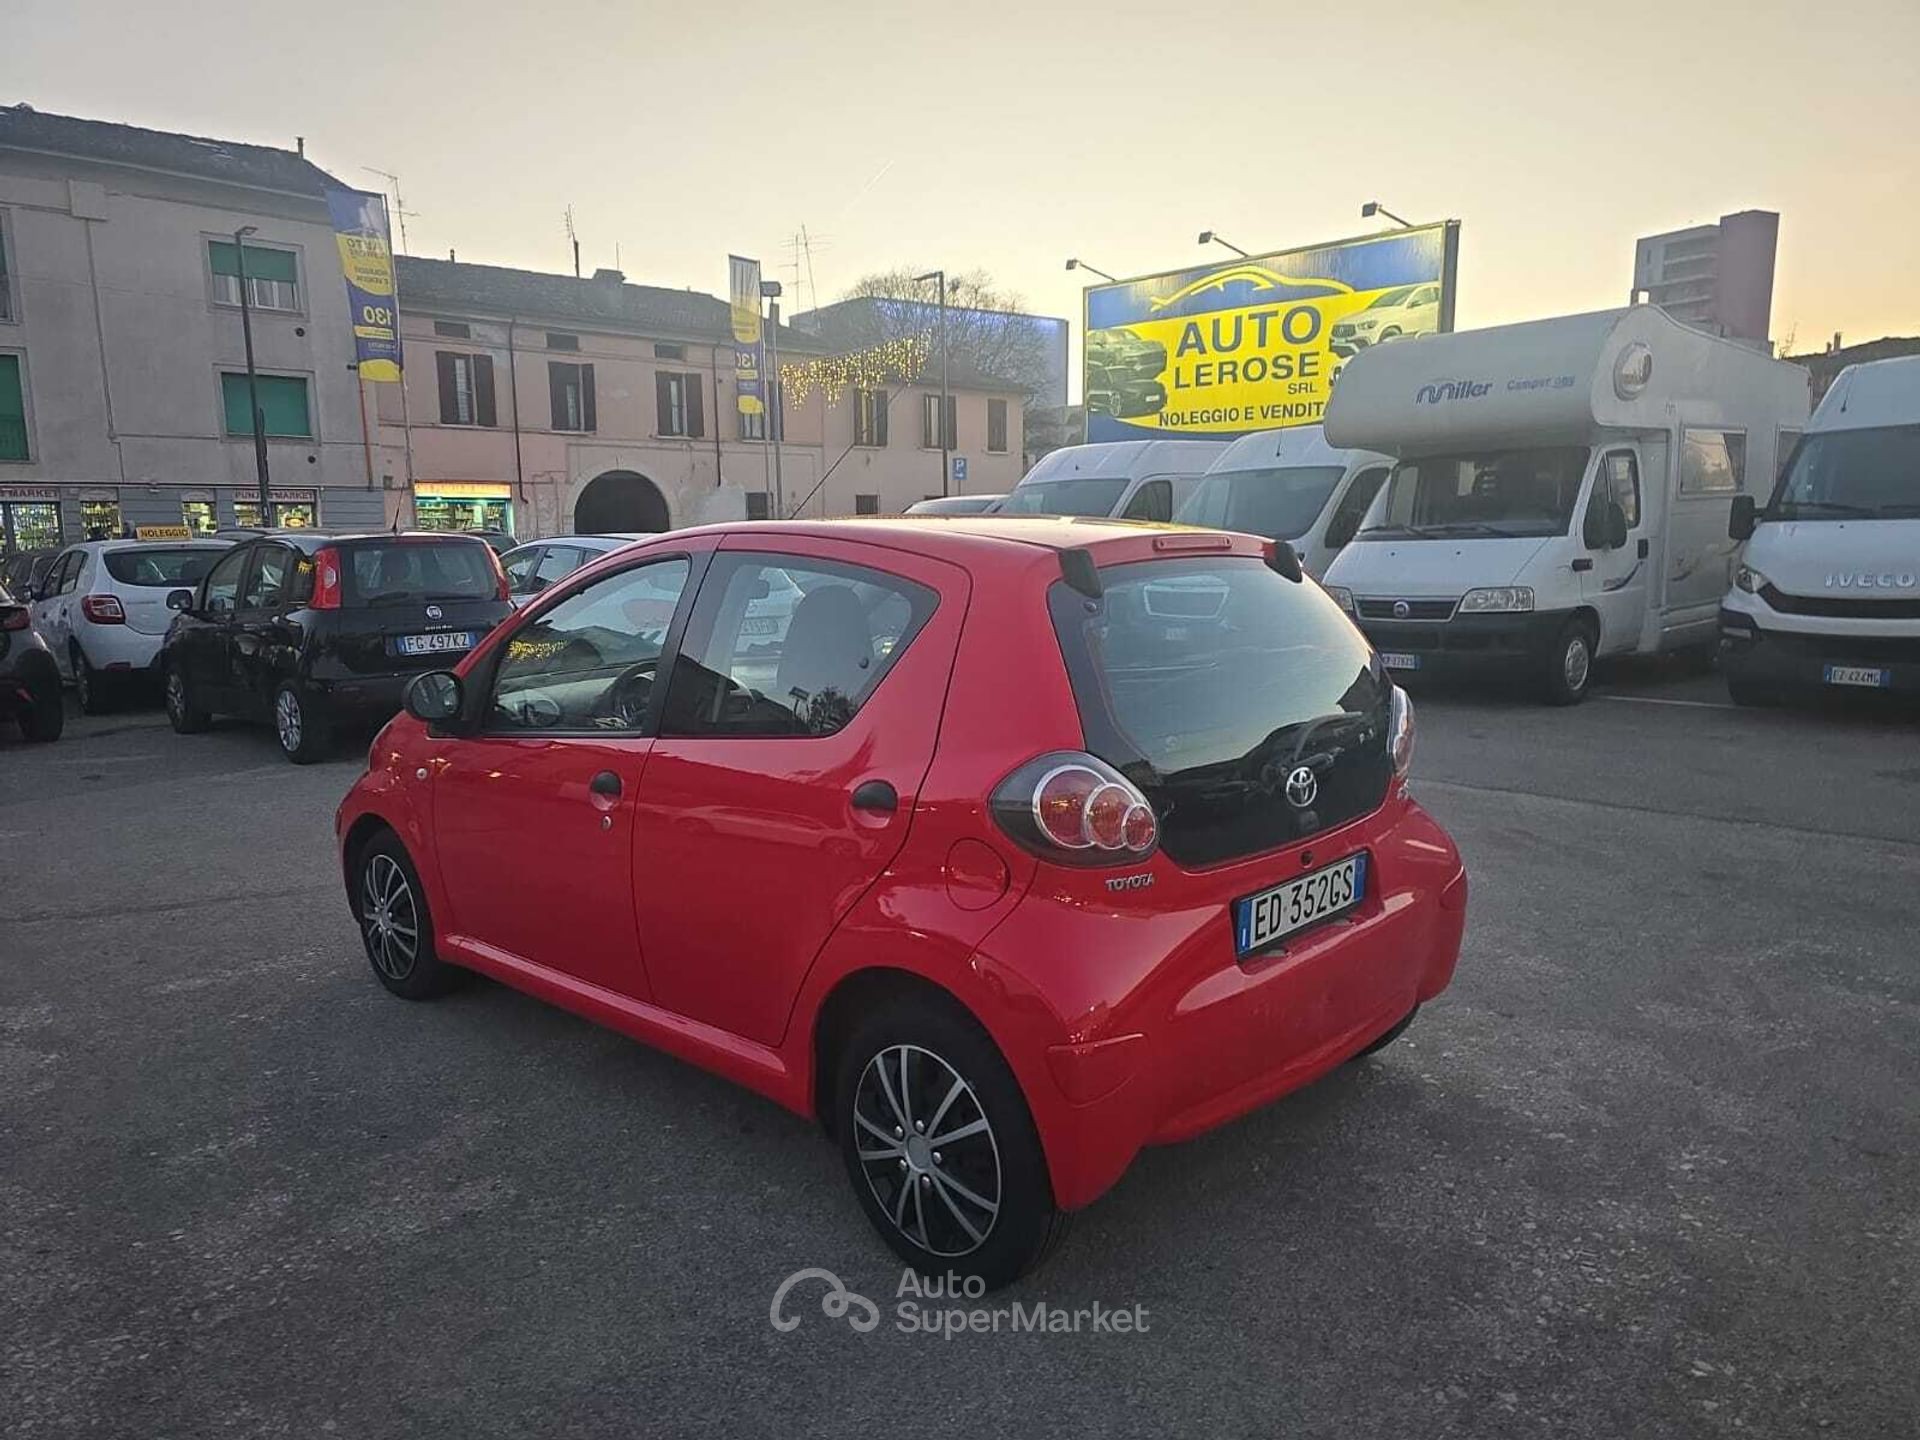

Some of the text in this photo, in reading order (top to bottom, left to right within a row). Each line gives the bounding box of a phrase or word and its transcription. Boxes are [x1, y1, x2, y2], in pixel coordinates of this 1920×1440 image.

[1175, 305, 1322, 357] AUTO
[1174, 351, 1320, 389] LEROSE
[1287, 382, 1318, 395] SRL
[1416, 380, 1493, 404] Miller
[1159, 401, 1325, 427] NOLEGGIO E VENDIT
[140, 528, 189, 538] NOLEGGIO
[1825, 575, 1916, 588] IVECO
[406, 632, 467, 650] FG 497KZ
[1105, 874, 1153, 891] TOYOTA
[1254, 864, 1354, 941] ED 352GS
